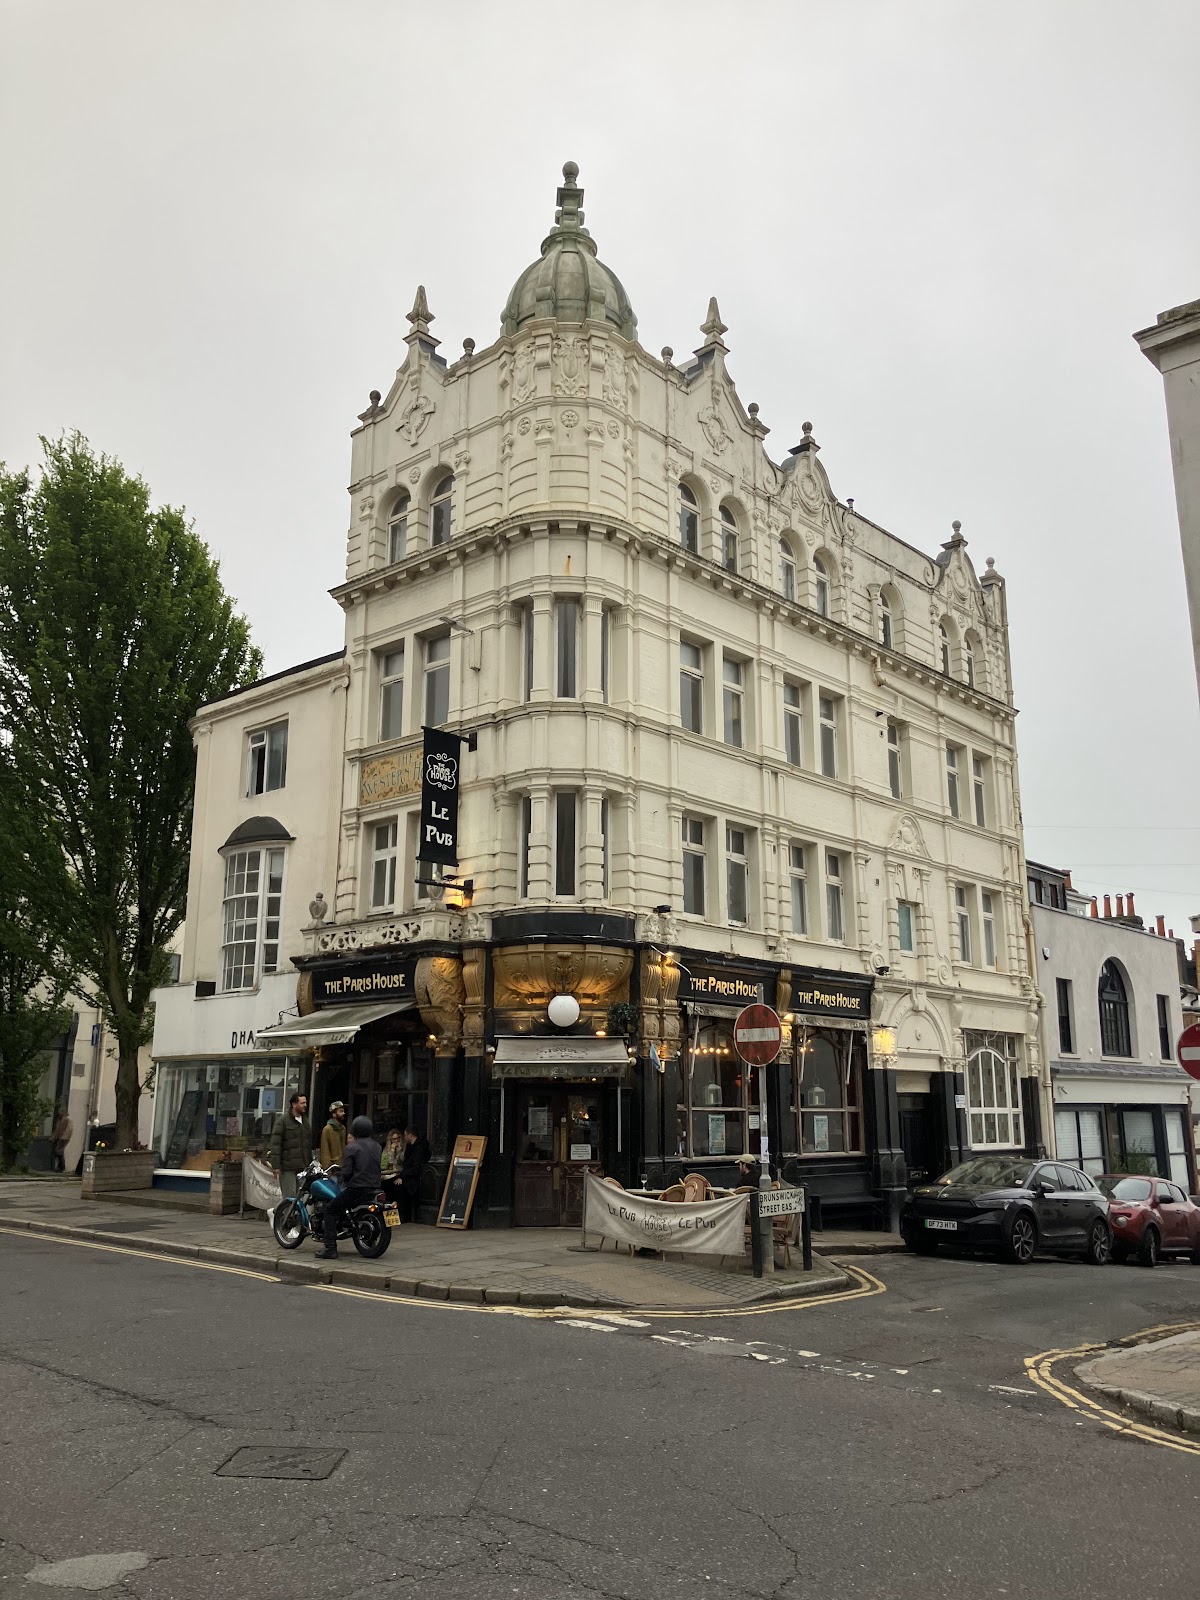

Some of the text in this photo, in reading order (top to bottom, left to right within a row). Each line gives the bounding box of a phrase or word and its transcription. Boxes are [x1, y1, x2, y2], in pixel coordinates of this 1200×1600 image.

[430, 769, 453, 783] HOUSE
[431, 800, 450, 820] LE
[425, 824, 453, 846] PUB
[324, 972, 406, 994] THE PARIS HOUSE
[689, 976, 759, 998] THE PARIS HOUS
[798, 990, 861, 1010] THE PARIS HOUSE
[231, 1030, 257, 1049] DHA
[759, 1191, 795, 1203] BRUNSWICK
[607, 1203, 637, 1222] LE PUB
[759, 1202, 797, 1215] STREET EAS
[644, 1219, 668, 1232] HOUSE
[678, 1216, 717, 1229] LE PUB
